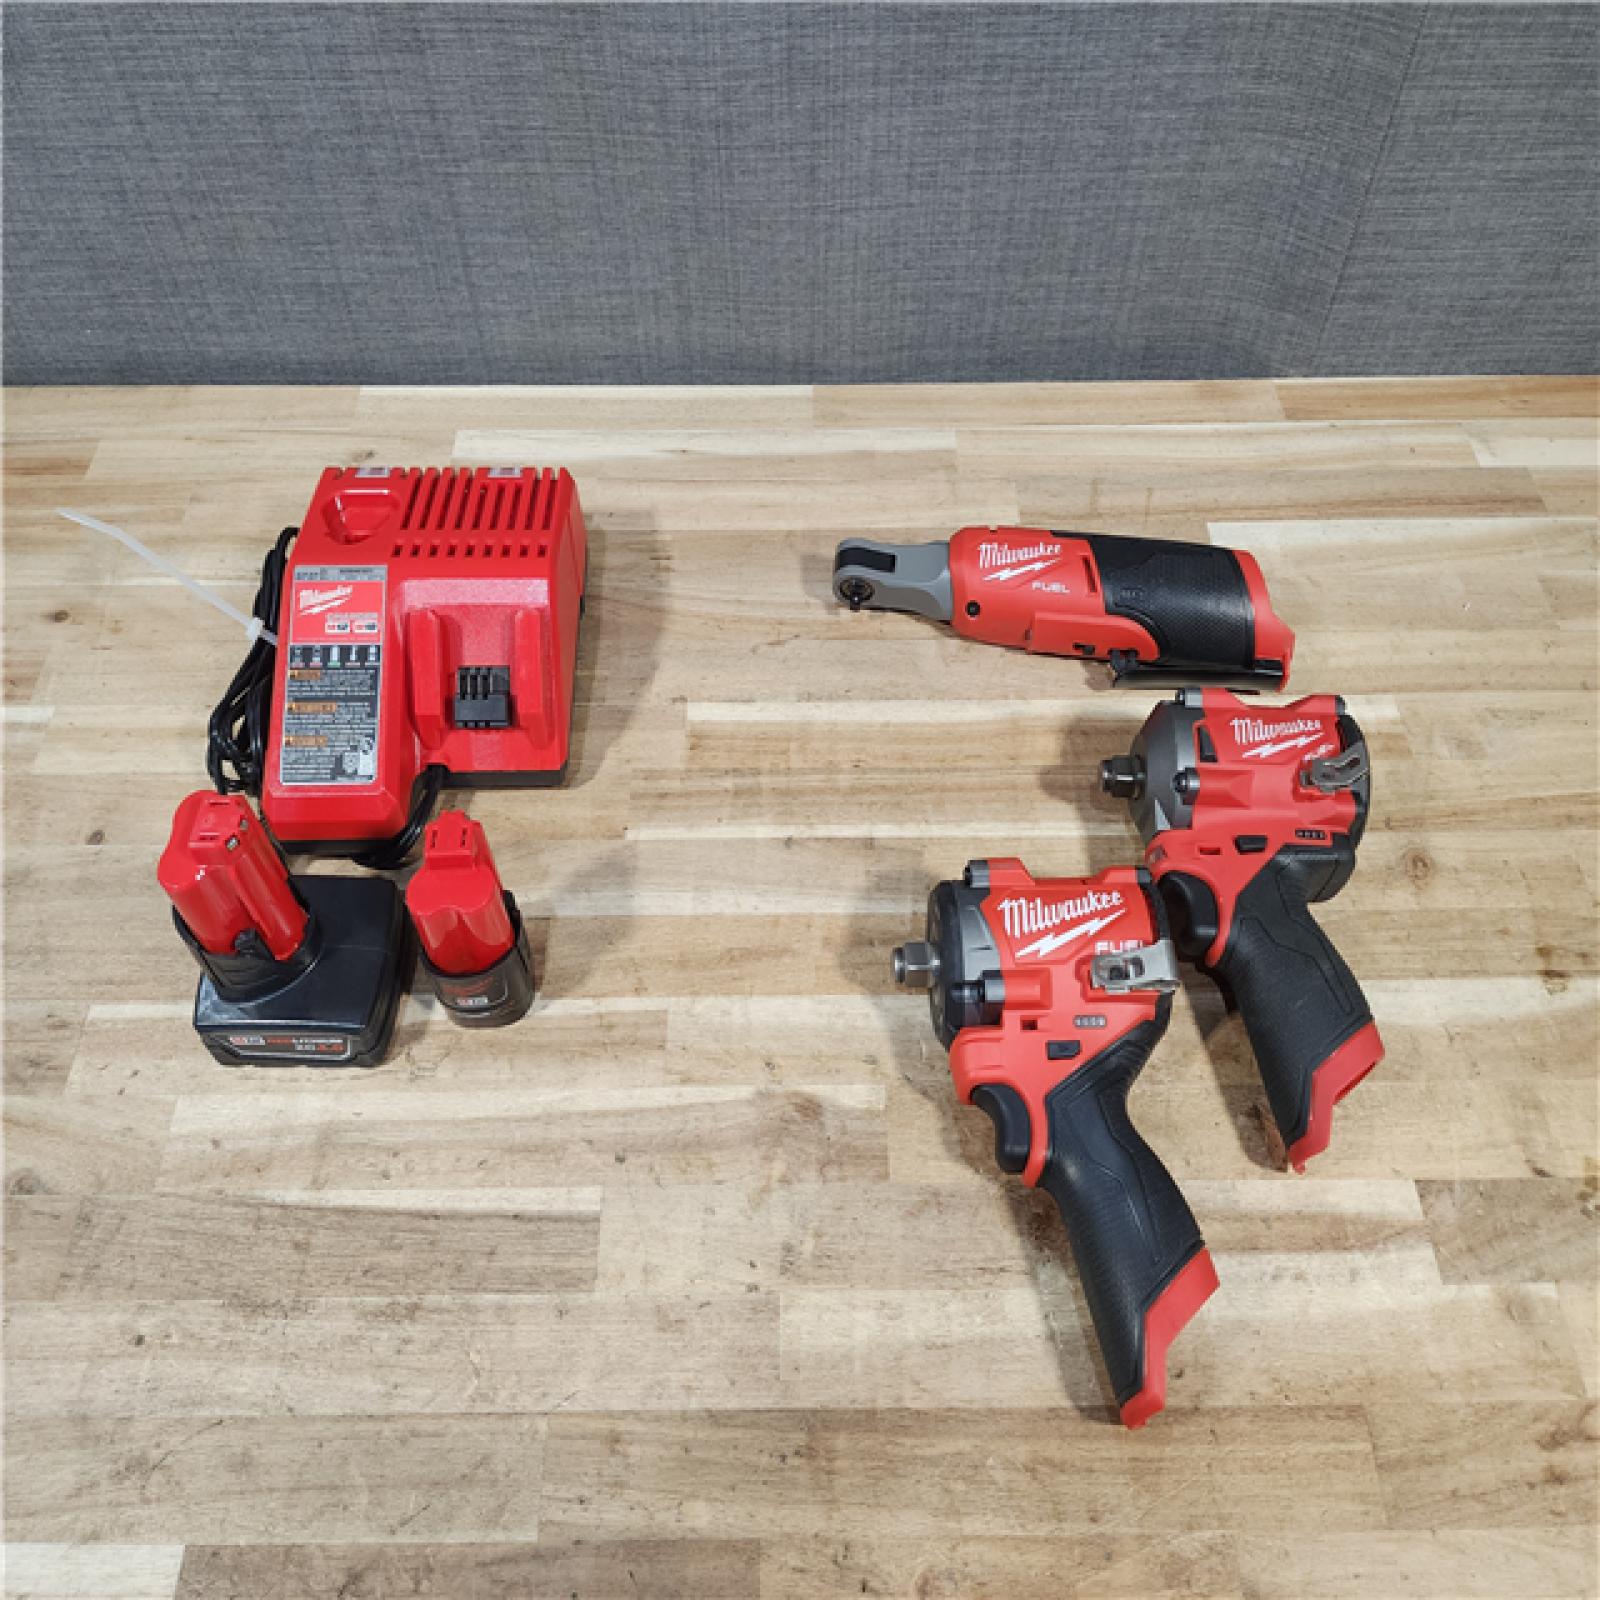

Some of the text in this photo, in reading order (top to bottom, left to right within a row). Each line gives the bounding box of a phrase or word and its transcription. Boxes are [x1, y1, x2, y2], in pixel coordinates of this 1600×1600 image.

[978, 542, 1063, 575] Milwaukee
[1031, 582, 1071, 594] FUEL
[1230, 717, 1322, 745] Milwaukee
[998, 890, 1124, 938] Milwaukee
